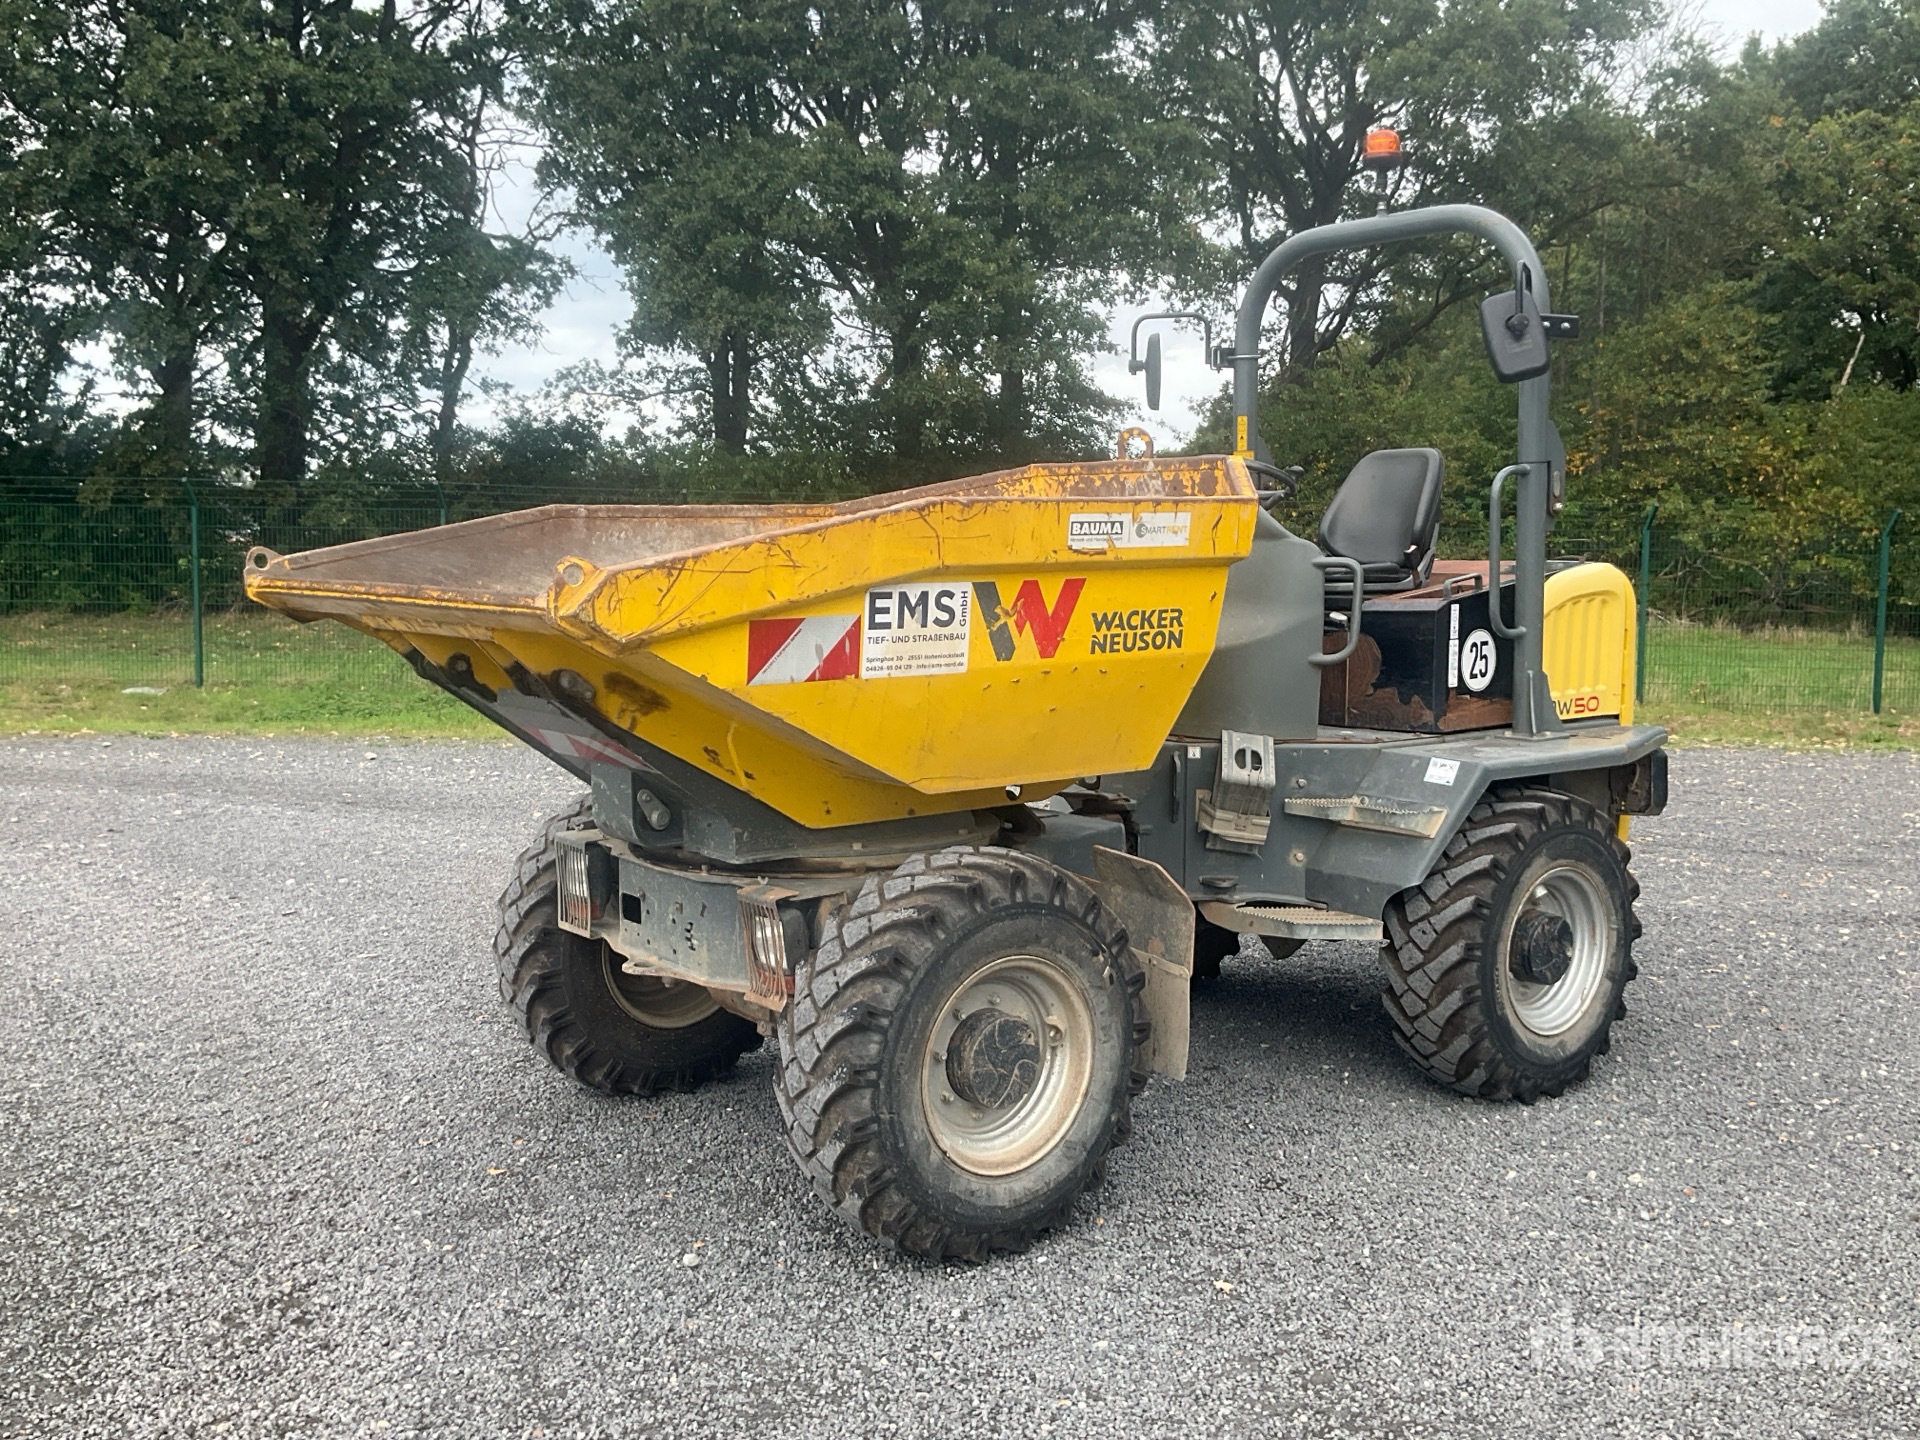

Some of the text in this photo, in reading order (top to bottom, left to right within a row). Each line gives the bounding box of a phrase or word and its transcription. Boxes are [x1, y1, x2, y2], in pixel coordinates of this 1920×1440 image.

[1072, 521, 1122, 535] BAUMA
[868, 589, 956, 630] EMS
[959, 590, 969, 627] GmbH
[1091, 608, 1184, 632] WACKER
[891, 635, 910, 644] UND
[1089, 629, 1183, 655] NEUSON
[1469, 640, 1489, 680] 25
